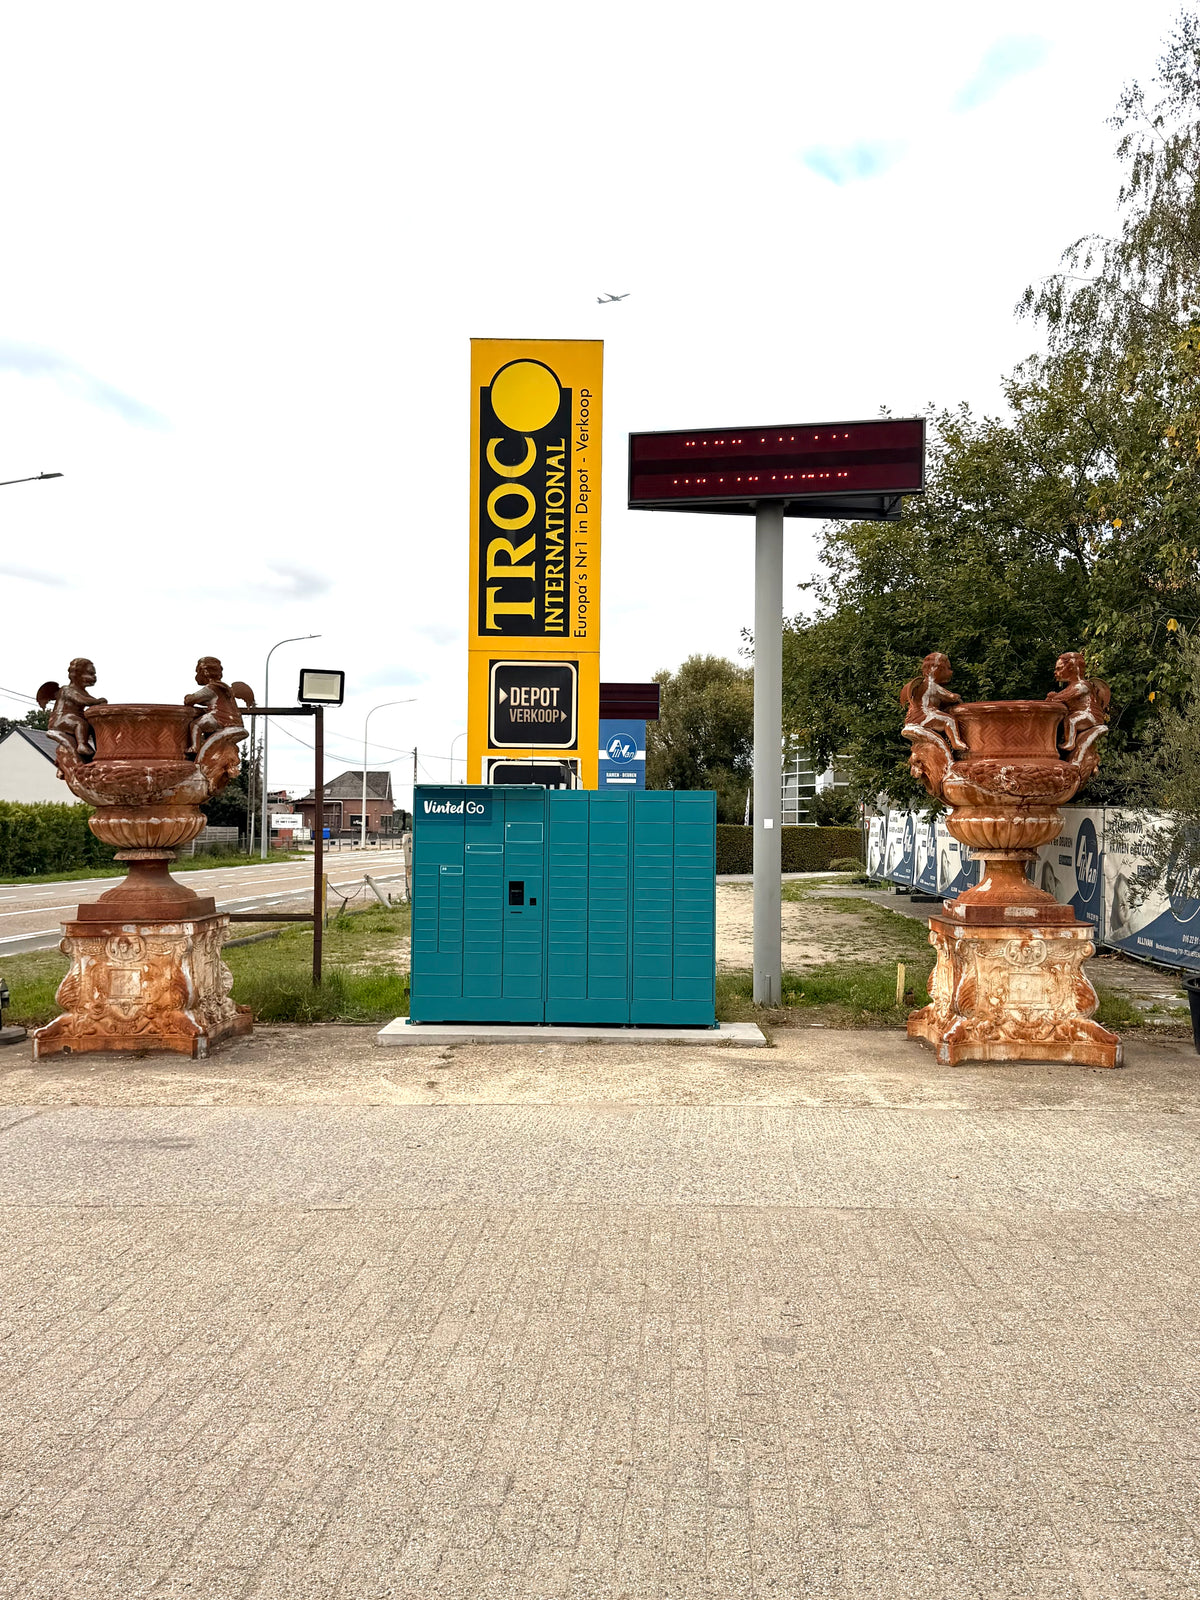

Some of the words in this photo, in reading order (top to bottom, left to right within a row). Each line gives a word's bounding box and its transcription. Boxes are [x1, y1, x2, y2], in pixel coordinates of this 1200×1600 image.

[575, 388, 592, 452] Verkoop
[575, 468, 592, 514] Depot
[544, 438, 566, 632] INTERNATIONAL
[575, 520, 588, 533] in
[574, 542, 588, 568] Nr1
[573, 573, 590, 637] Europa's
[510, 686, 560, 707] DEPOT
[509, 708, 559, 723] VERKOOP
[423, 800, 465, 815] Vinted
[466, 801, 485, 814] Go
